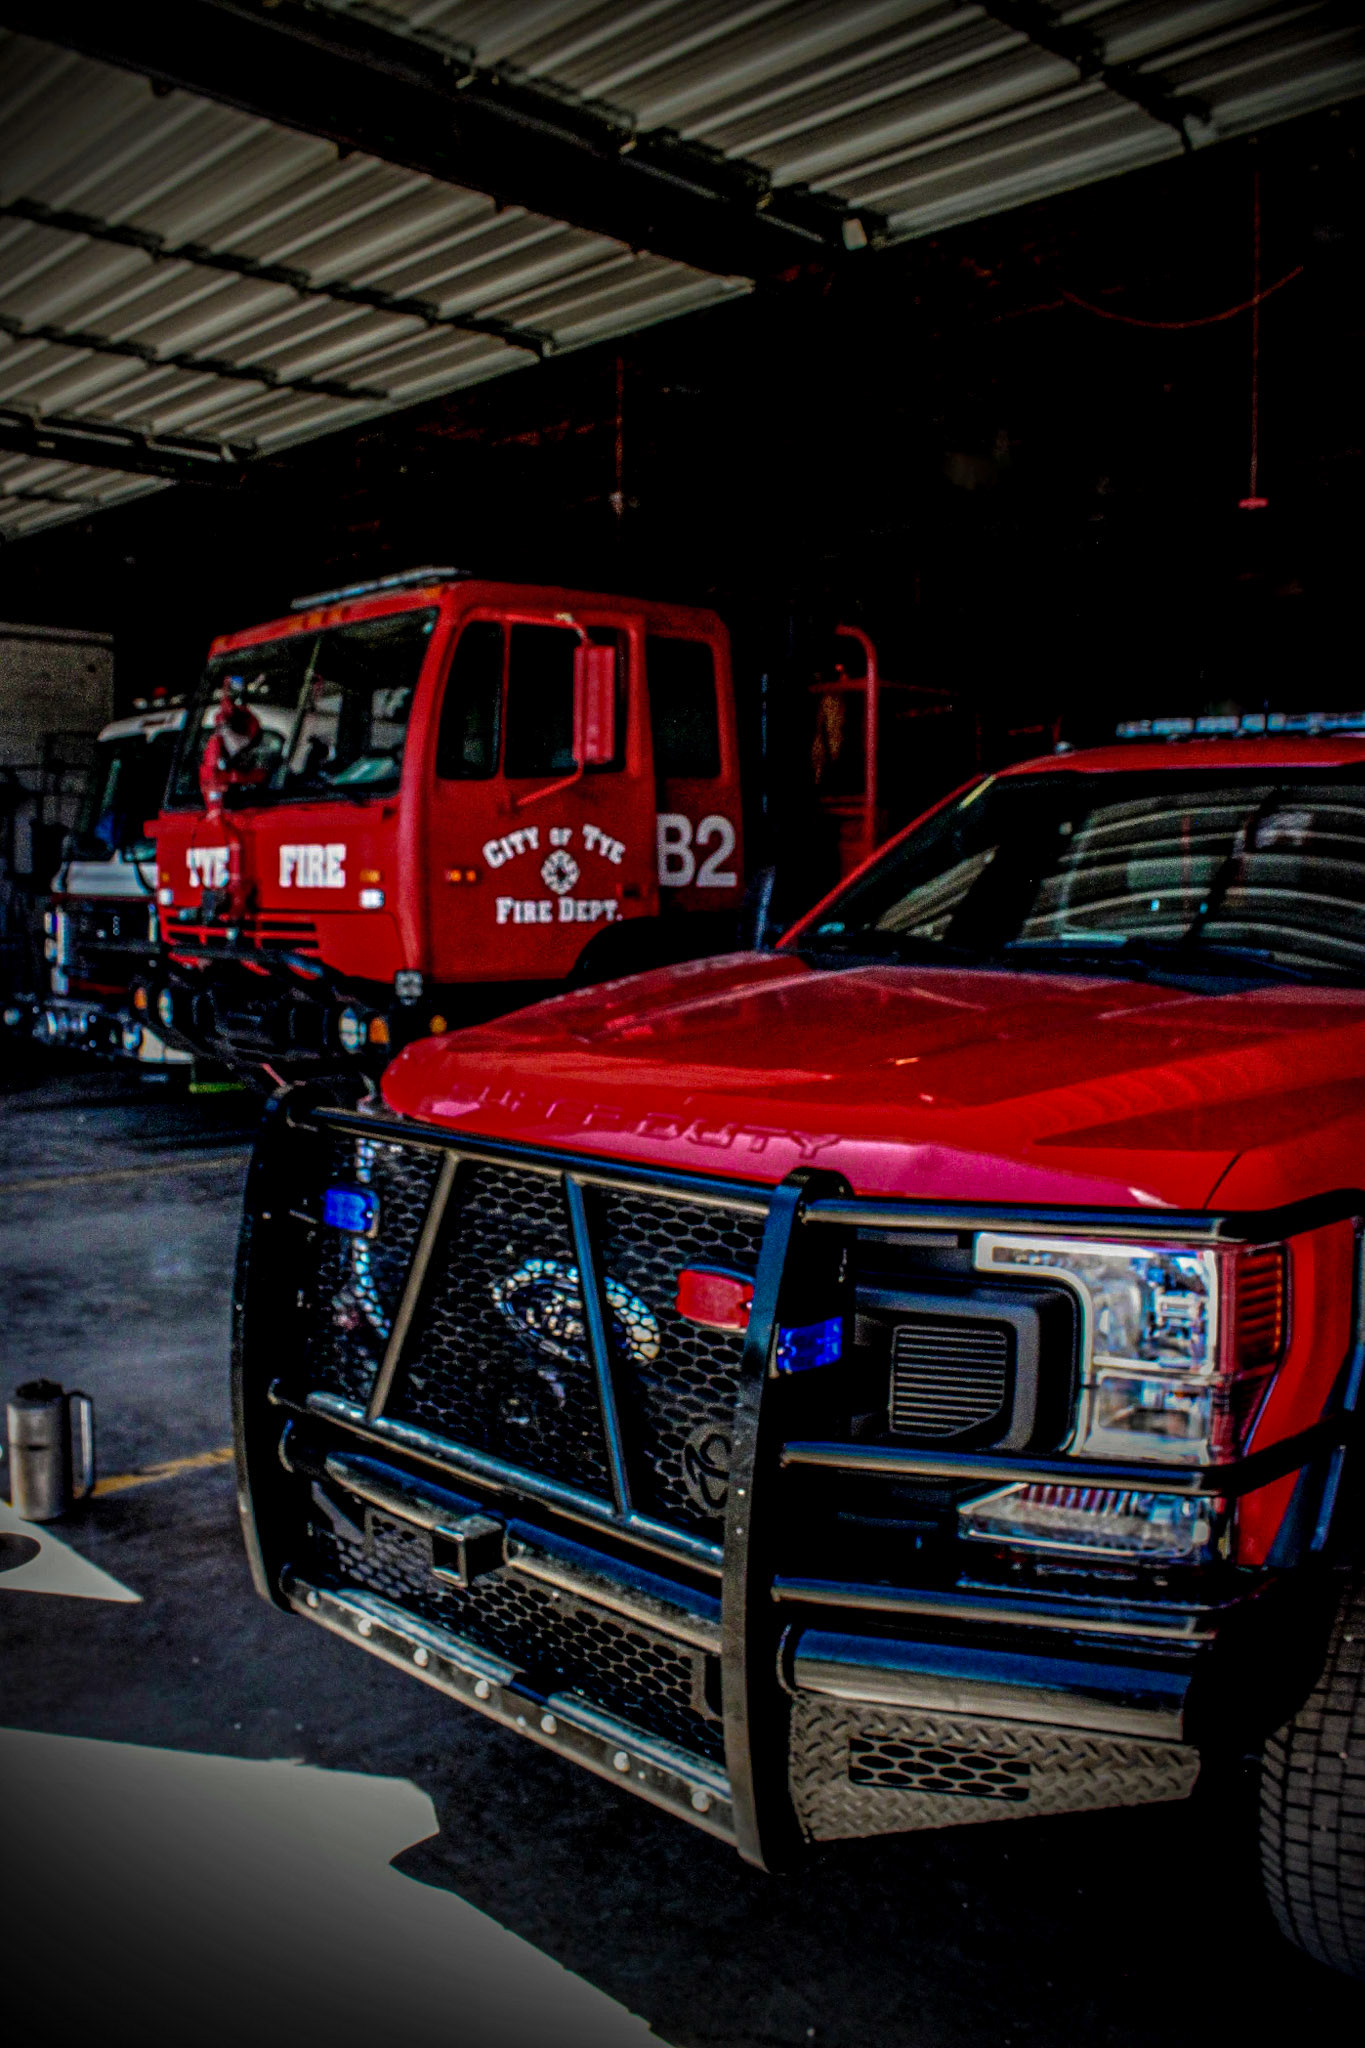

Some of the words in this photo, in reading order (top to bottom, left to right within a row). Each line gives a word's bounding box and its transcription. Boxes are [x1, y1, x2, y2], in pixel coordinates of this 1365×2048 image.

[278, 843, 347, 889] FIRE
[482, 825, 540, 869] CITY
[581, 822, 627, 865] TYE
[656, 812, 738, 888] B2
[495, 896, 553, 925] FIRE
[558, 896, 624, 923] DEPT.
